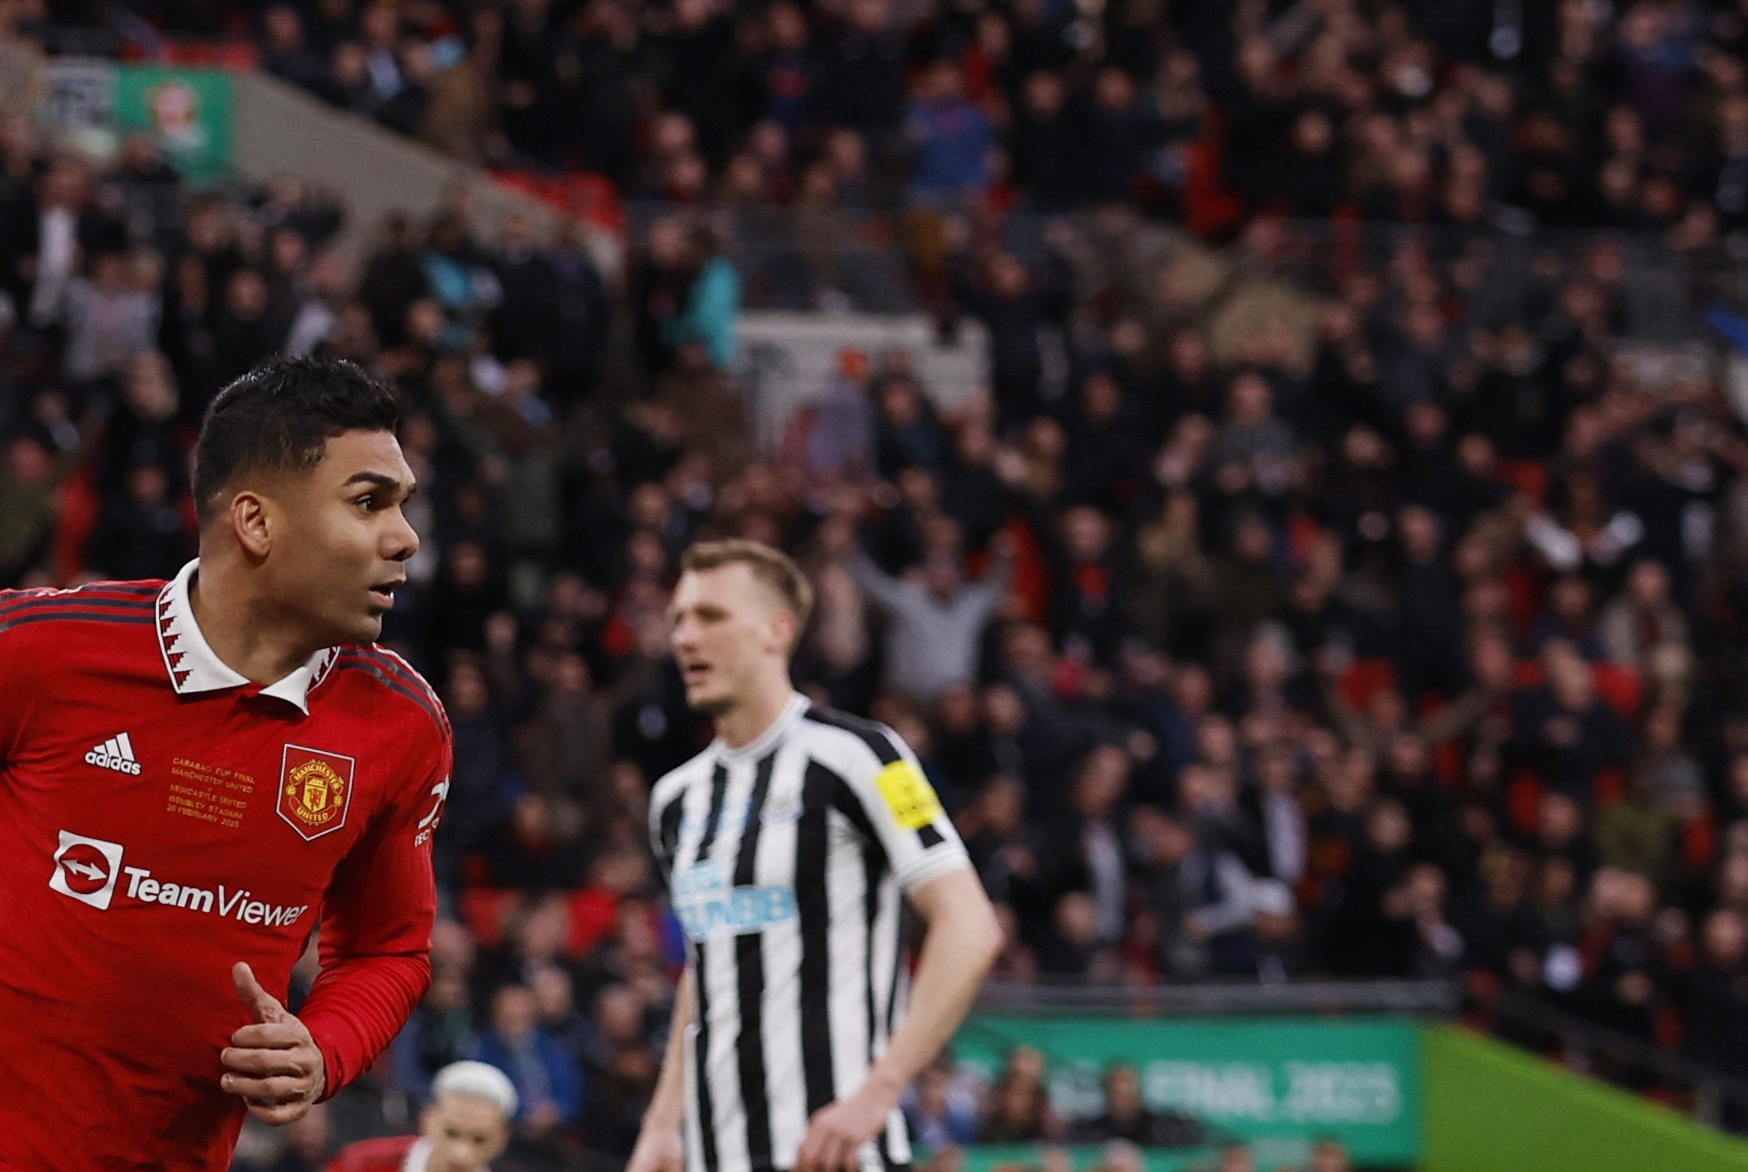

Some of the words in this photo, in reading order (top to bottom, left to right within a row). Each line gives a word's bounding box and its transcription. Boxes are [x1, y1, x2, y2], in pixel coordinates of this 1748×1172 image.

[85, 751, 141, 776] adidas
[292, 763, 341, 791] MANCHESTER
[295, 806, 330, 822] UNITED
[123, 865, 309, 928] TeamViewer
